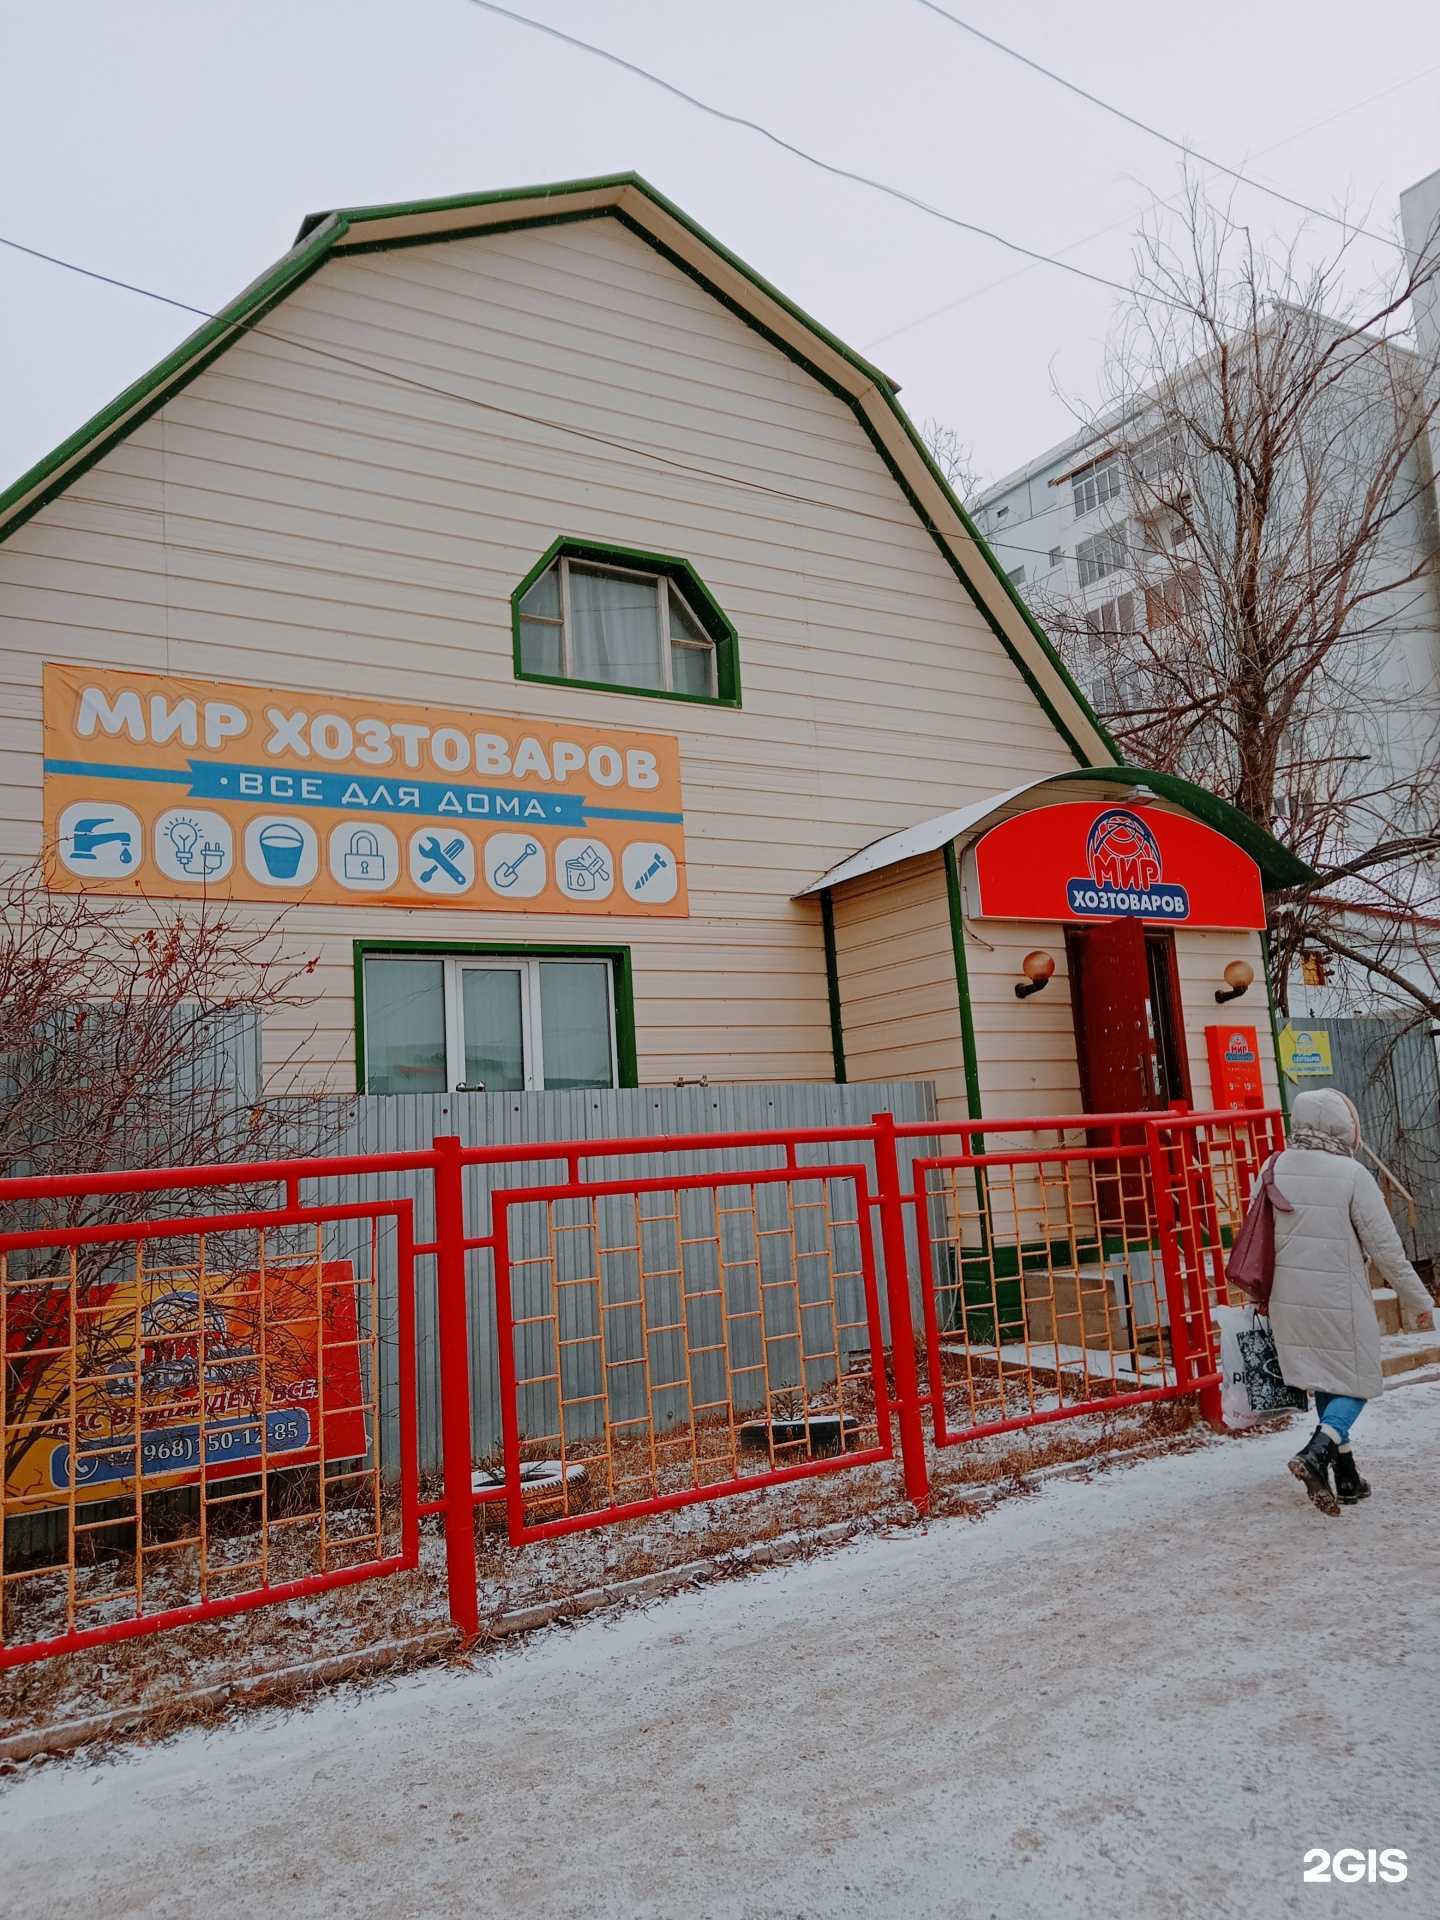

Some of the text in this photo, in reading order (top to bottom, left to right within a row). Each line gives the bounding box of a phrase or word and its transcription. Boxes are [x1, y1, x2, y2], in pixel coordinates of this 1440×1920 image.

[76, 687, 661, 790] МИР ХОЗТОВАРОВ
[239, 772, 548, 819] ВСЕ ДЛЯ ДОМА
[1092, 853, 1160, 892] МИР
[1072, 889, 1185, 913] ХОЗТОВАРОВ
